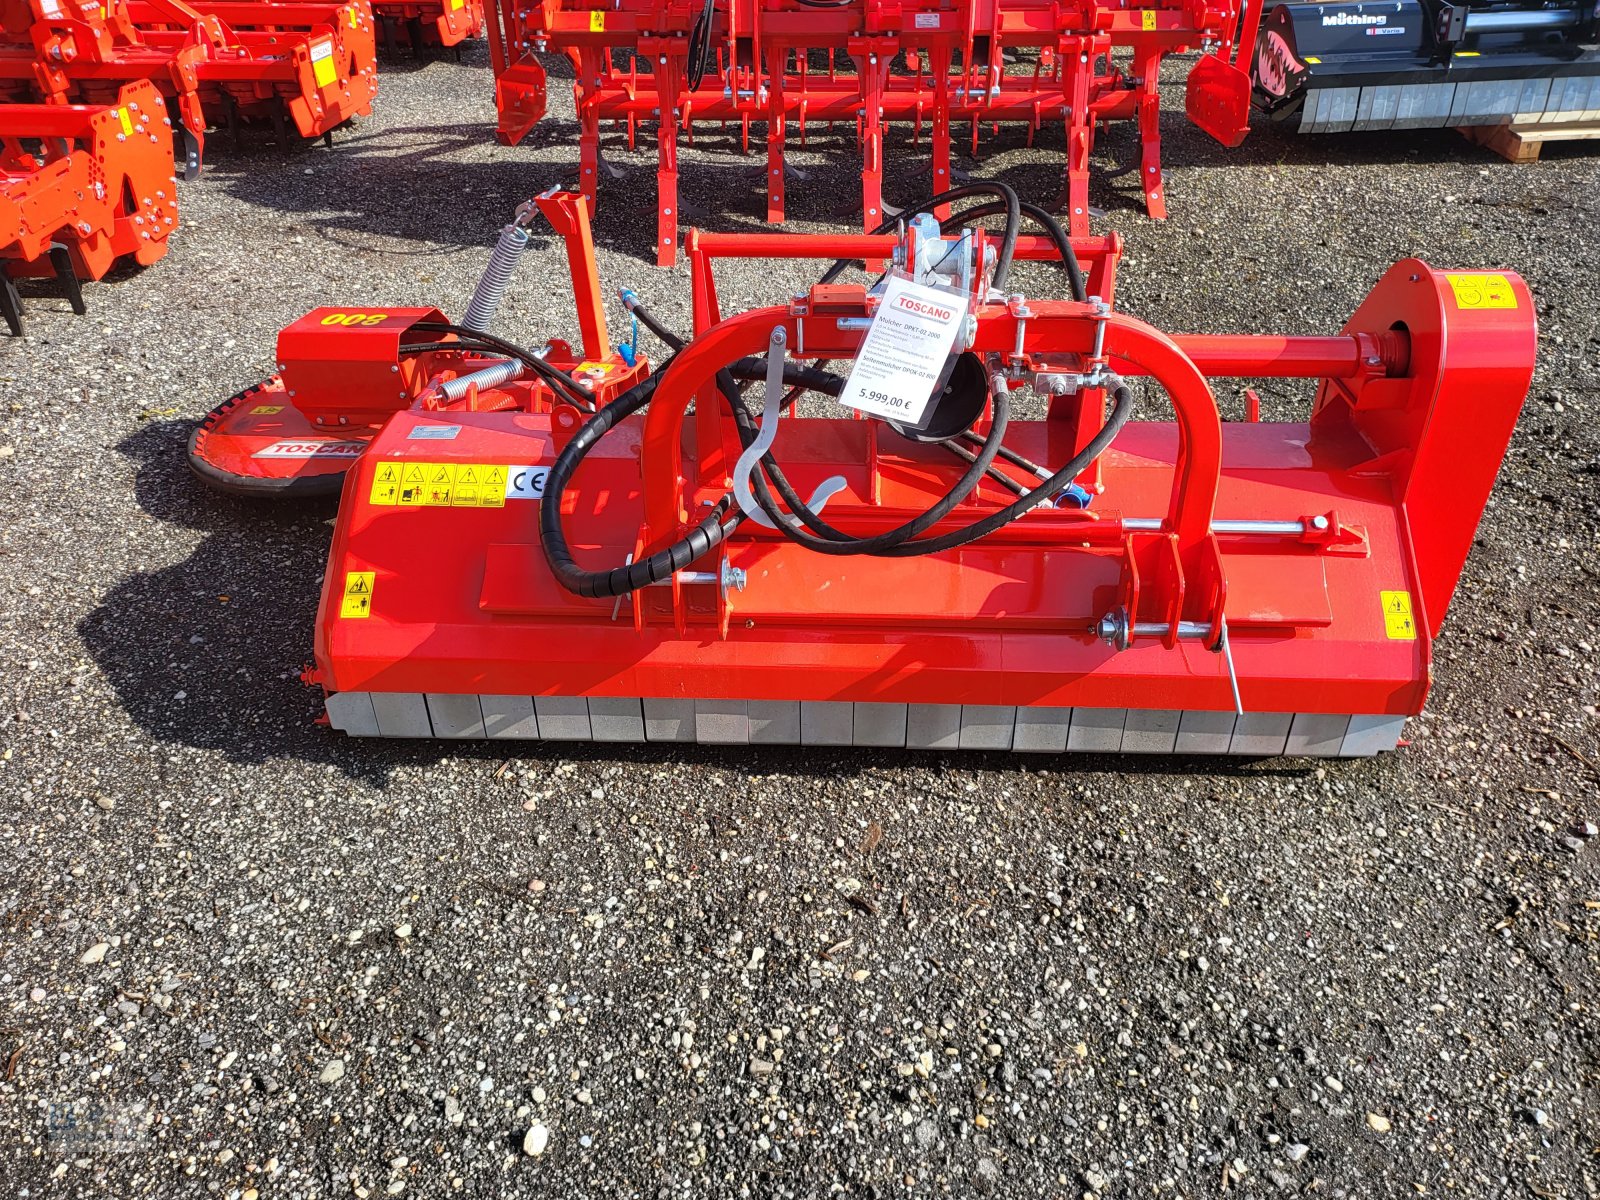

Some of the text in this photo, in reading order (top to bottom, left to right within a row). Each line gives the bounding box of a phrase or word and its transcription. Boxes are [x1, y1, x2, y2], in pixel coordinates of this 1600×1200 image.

[1322, 12, 1387, 26] Müthing
[899, 297, 951, 320] TOSCANO
[879, 316, 902, 329] Mulcher
[862, 355, 902, 371] Seitenmulcher
[859, 388, 912, 410] 5.999,00 €
[275, 444, 365, 454] TOSCAN
[513, 471, 545, 492] CE
